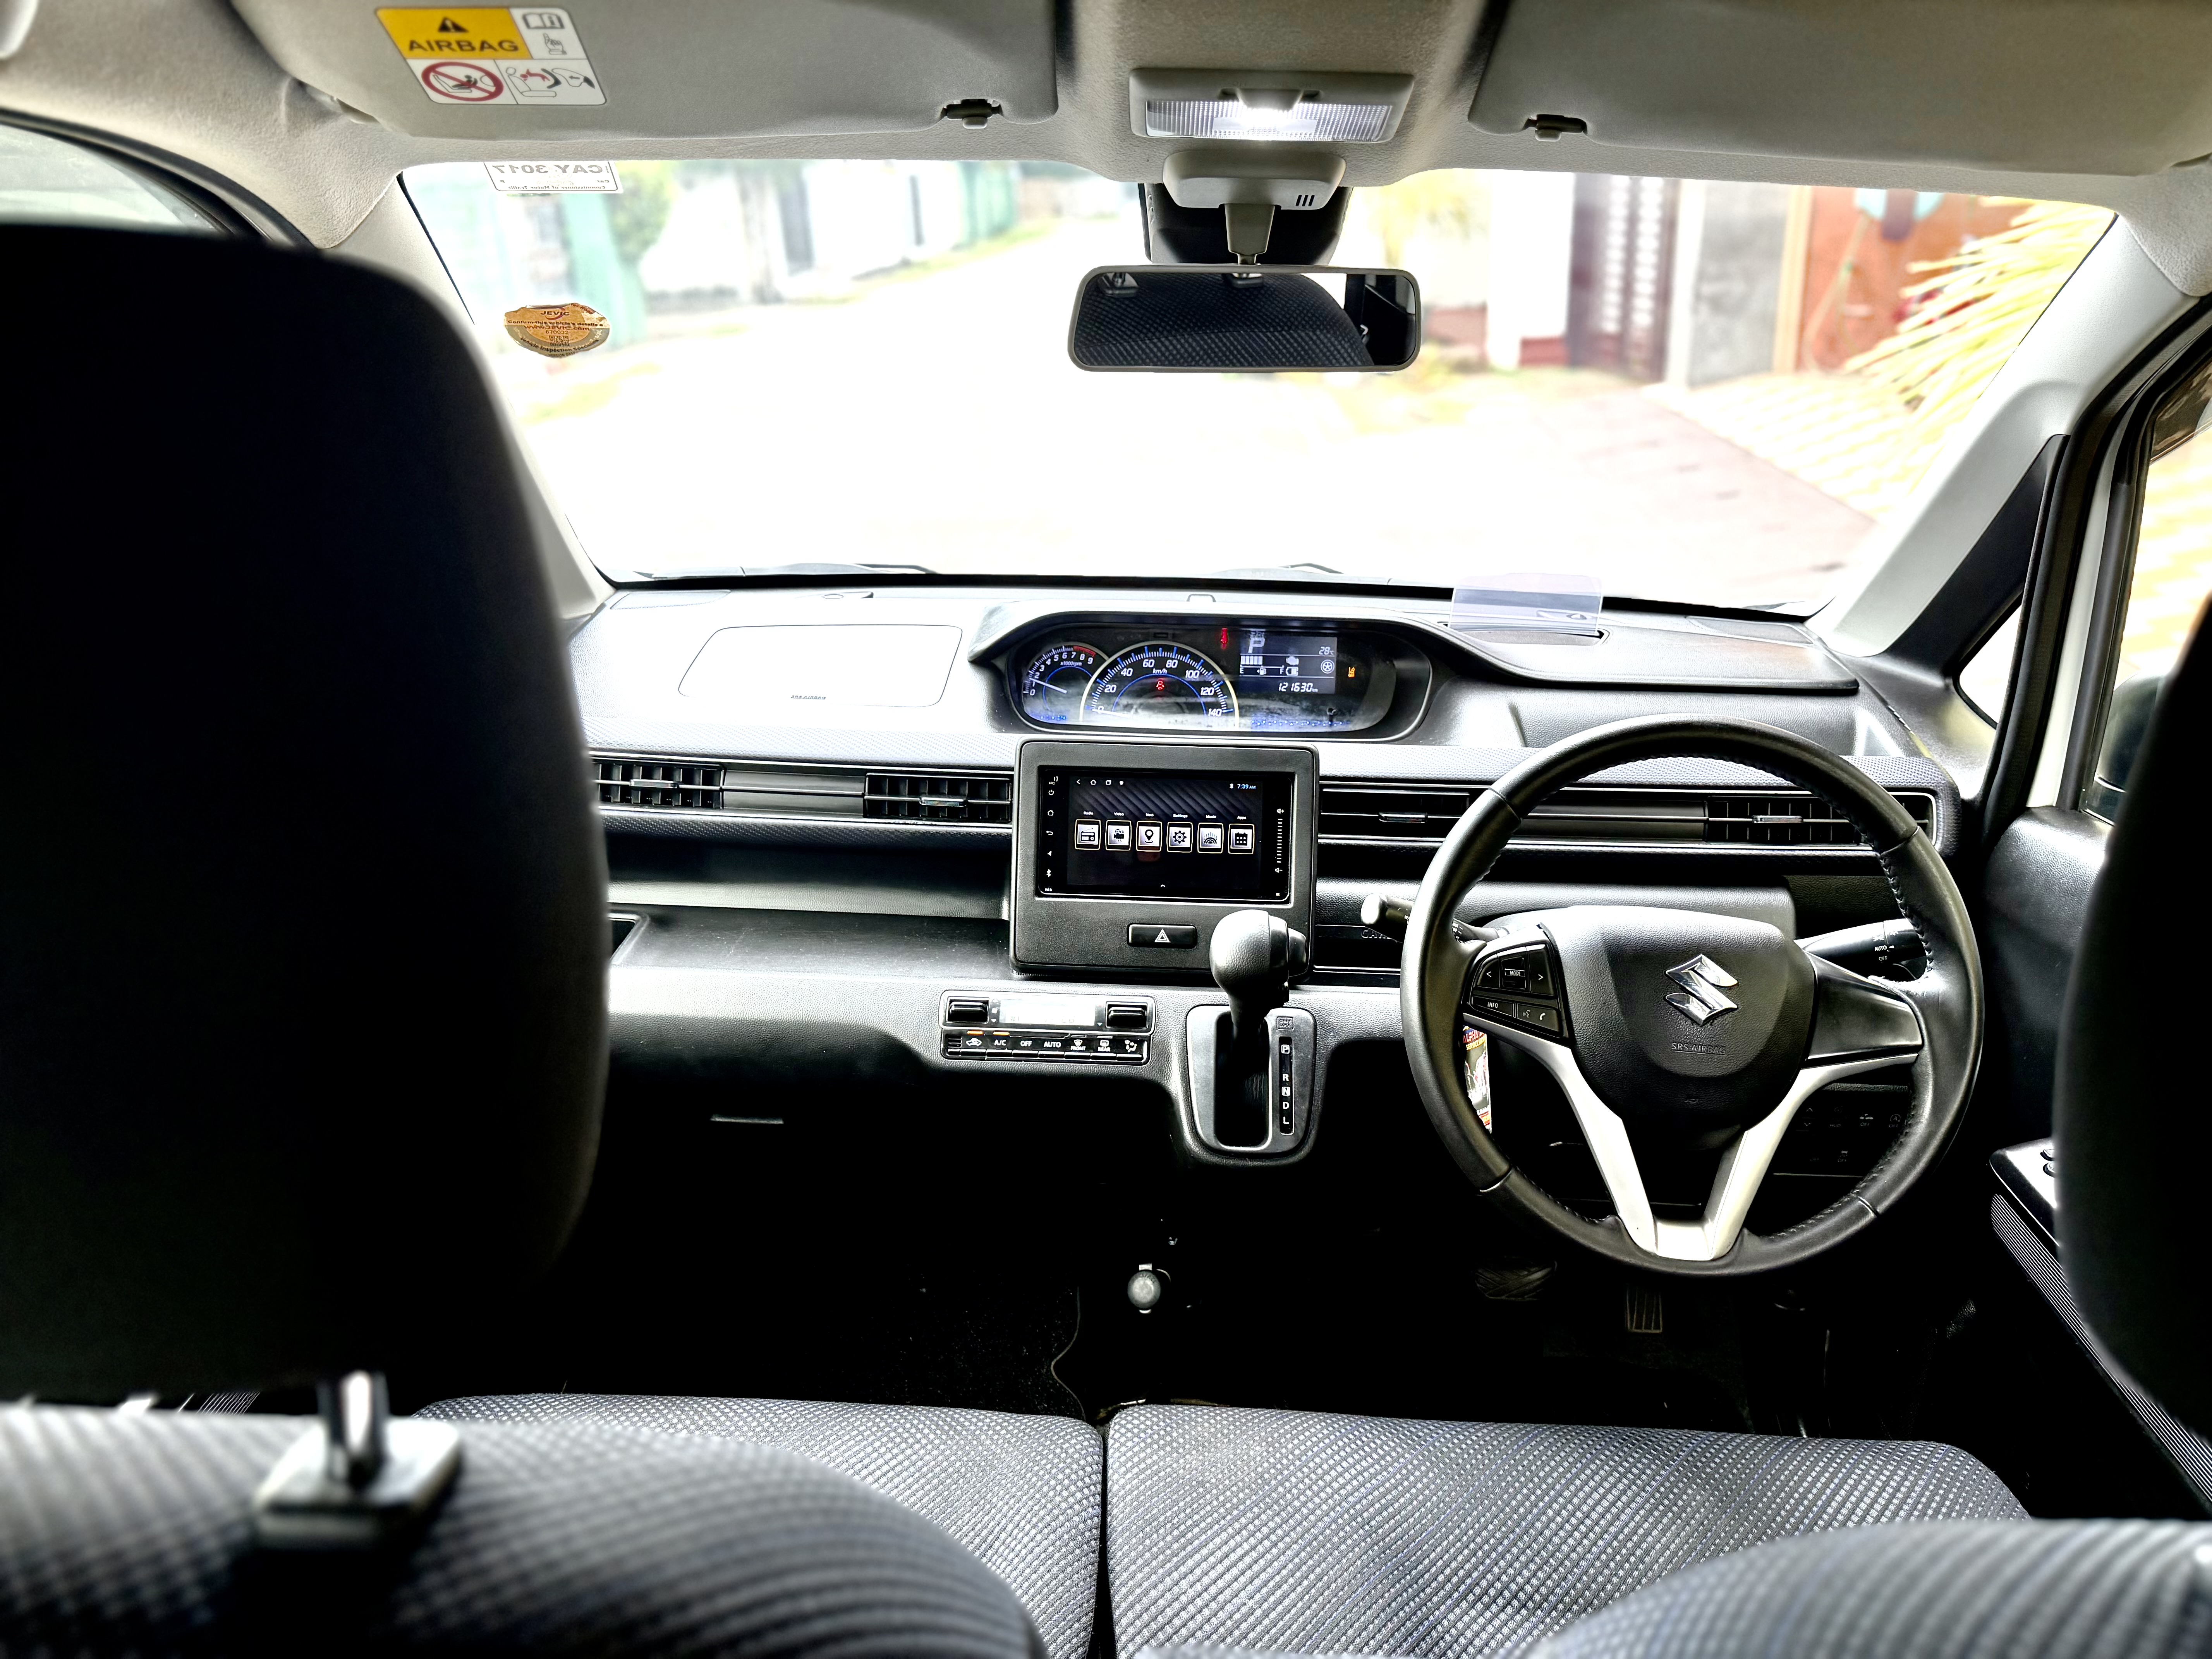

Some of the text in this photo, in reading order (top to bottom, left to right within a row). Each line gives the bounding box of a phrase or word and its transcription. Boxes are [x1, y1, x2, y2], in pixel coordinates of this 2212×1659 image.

[409, 40, 519, 53] AIRBAG
[1248, 637, 1265, 653] P
[1104, 684, 1116, 693] 20
[1121, 668, 1133, 677] 40
[1143, 659, 1155, 668] 60
[1166, 659, 1178, 668] 80
[1186, 670, 1199, 678] 100
[1200, 687, 1214, 696] 120
[1208, 708, 1222, 717] 140
[1671, 1042, 1726, 1054] SRS AIRBAG
